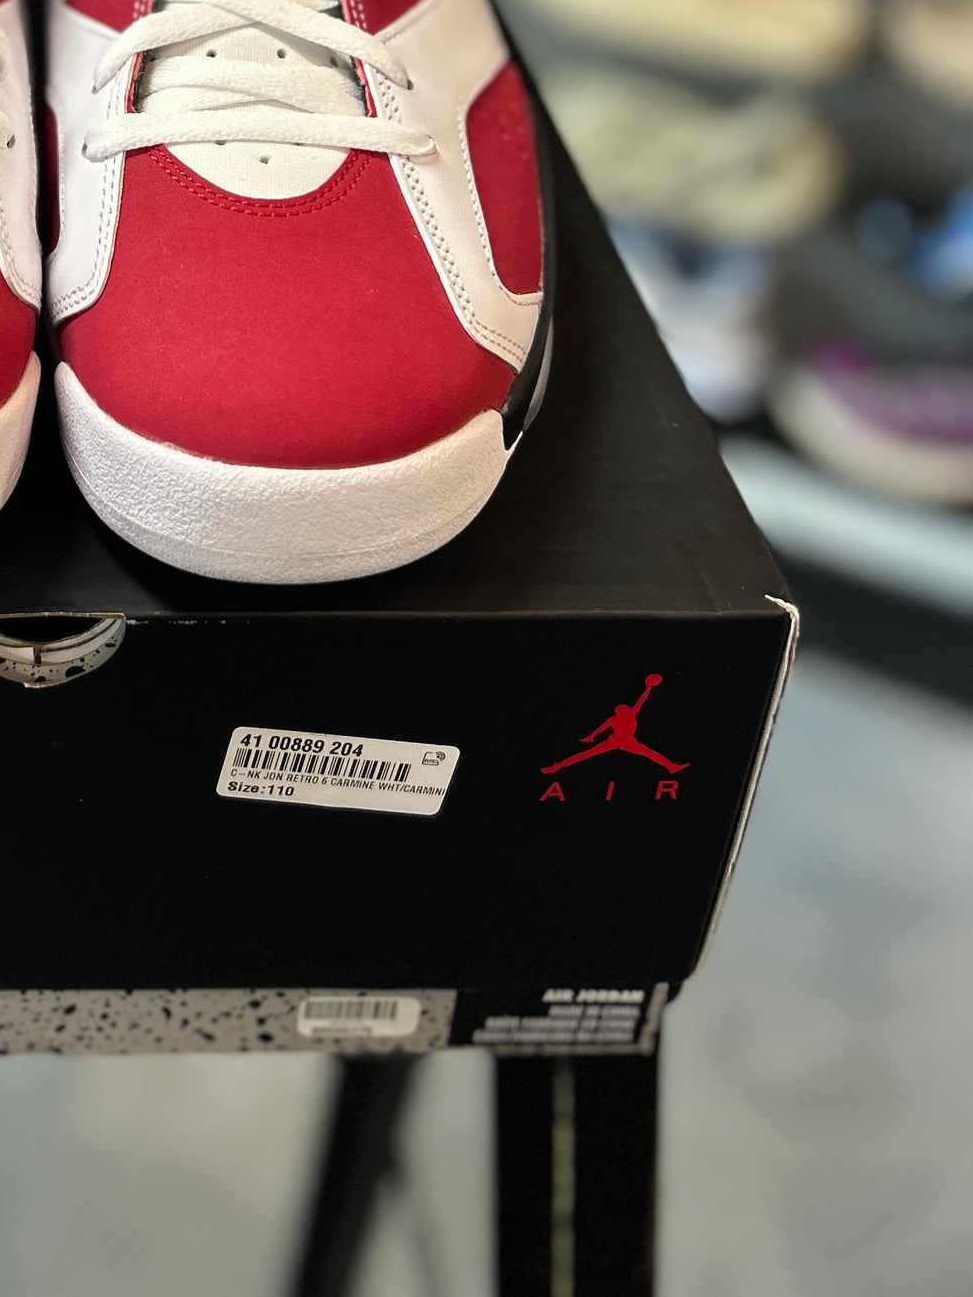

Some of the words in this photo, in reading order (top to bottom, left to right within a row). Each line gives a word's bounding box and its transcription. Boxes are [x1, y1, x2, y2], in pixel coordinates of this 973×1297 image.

[240, 734, 262, 748] 41
[268, 735, 325, 753] 00889
[329, 741, 364, 757] 204
[263, 771, 284, 781] JDN
[286, 773, 319, 785] RETRO
[321, 776, 329, 785] 6
[330, 777, 376, 790] CARMINE
[539, 780, 679, 801] AIR
